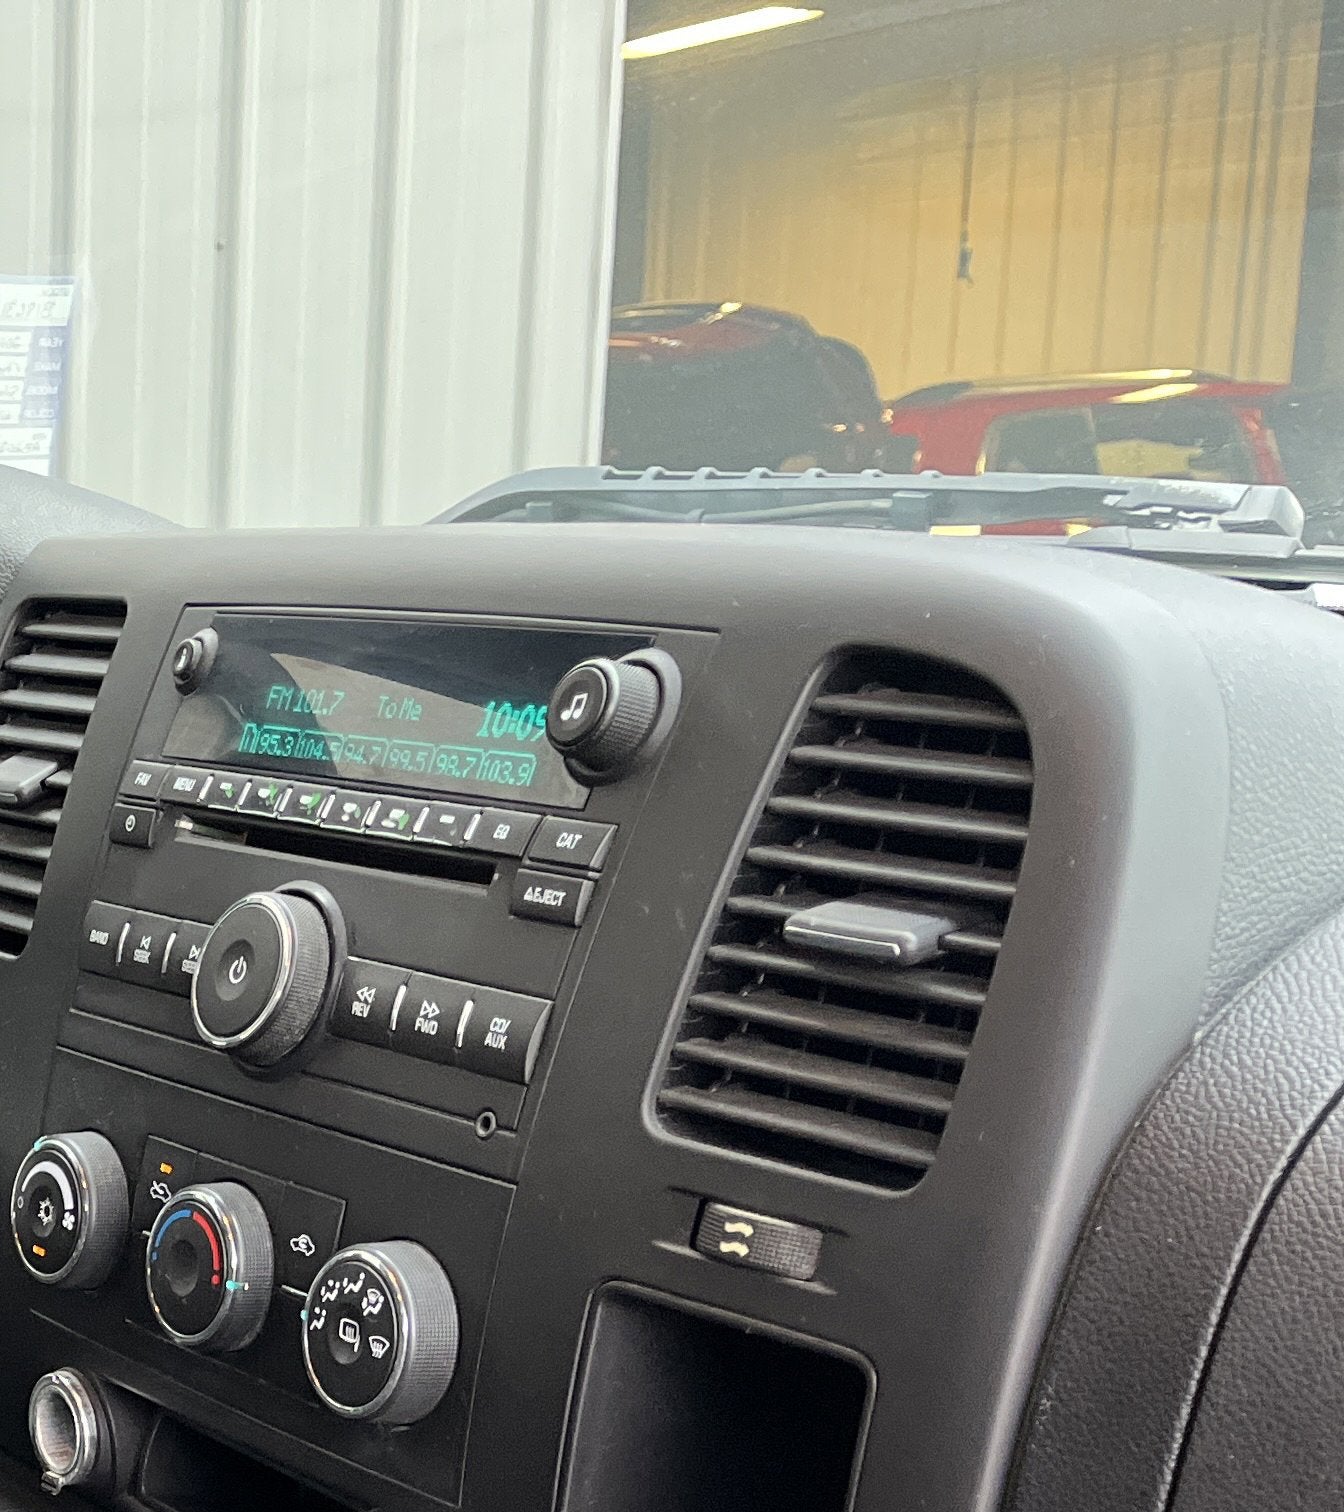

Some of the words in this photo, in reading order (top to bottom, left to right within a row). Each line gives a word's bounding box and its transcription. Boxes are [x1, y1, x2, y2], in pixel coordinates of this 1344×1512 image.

[258, 733, 295, 757] 95.3
[134, 771, 152, 786] FAV
[555, 832, 583, 850] CAT
[534, 888, 567, 907] EJECT
[351, 1000, 371, 1018] REV
[414, 1017, 438, 1036] FWD
[484, 1032, 508, 1051] AUX
